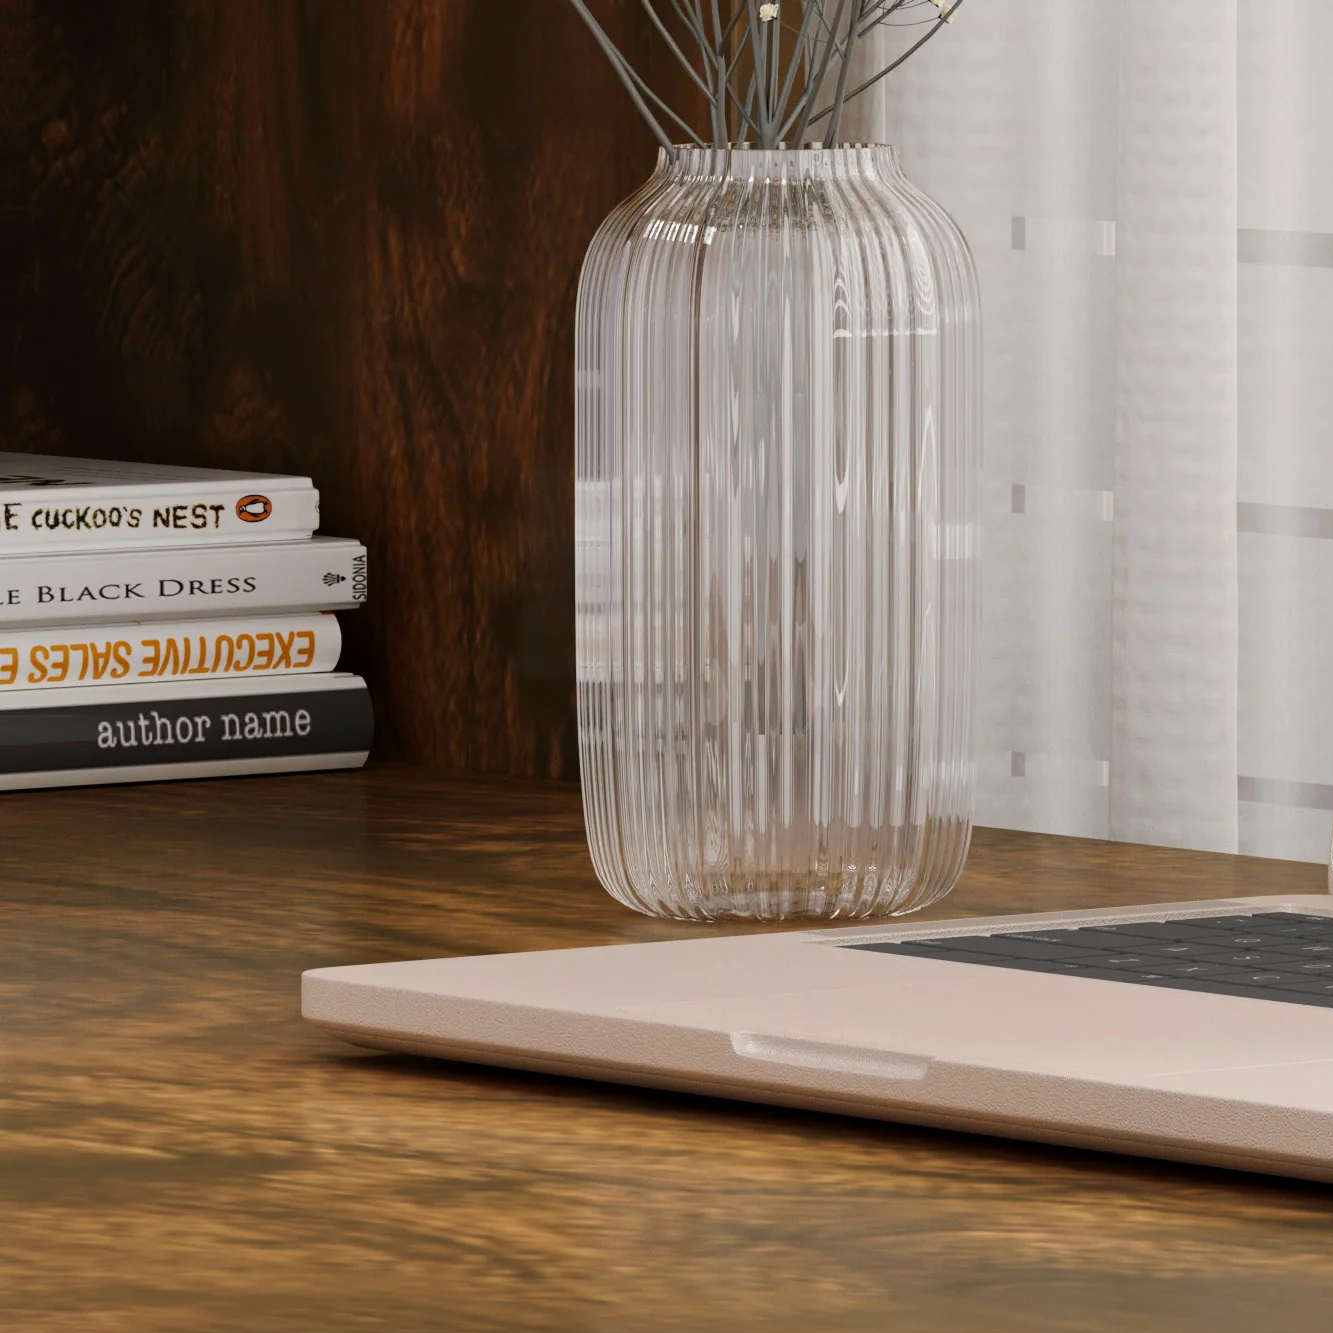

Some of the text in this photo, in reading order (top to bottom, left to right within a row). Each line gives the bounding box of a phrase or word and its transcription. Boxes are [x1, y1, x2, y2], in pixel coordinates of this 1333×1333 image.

[152, 504, 226, 530] NEST
[352, 555, 367, 601] SIDONIA
[27, 640, 133, 684] SALES
[138, 630, 316, 678] EXECUTIVE
[97, 709, 311, 748] author name
